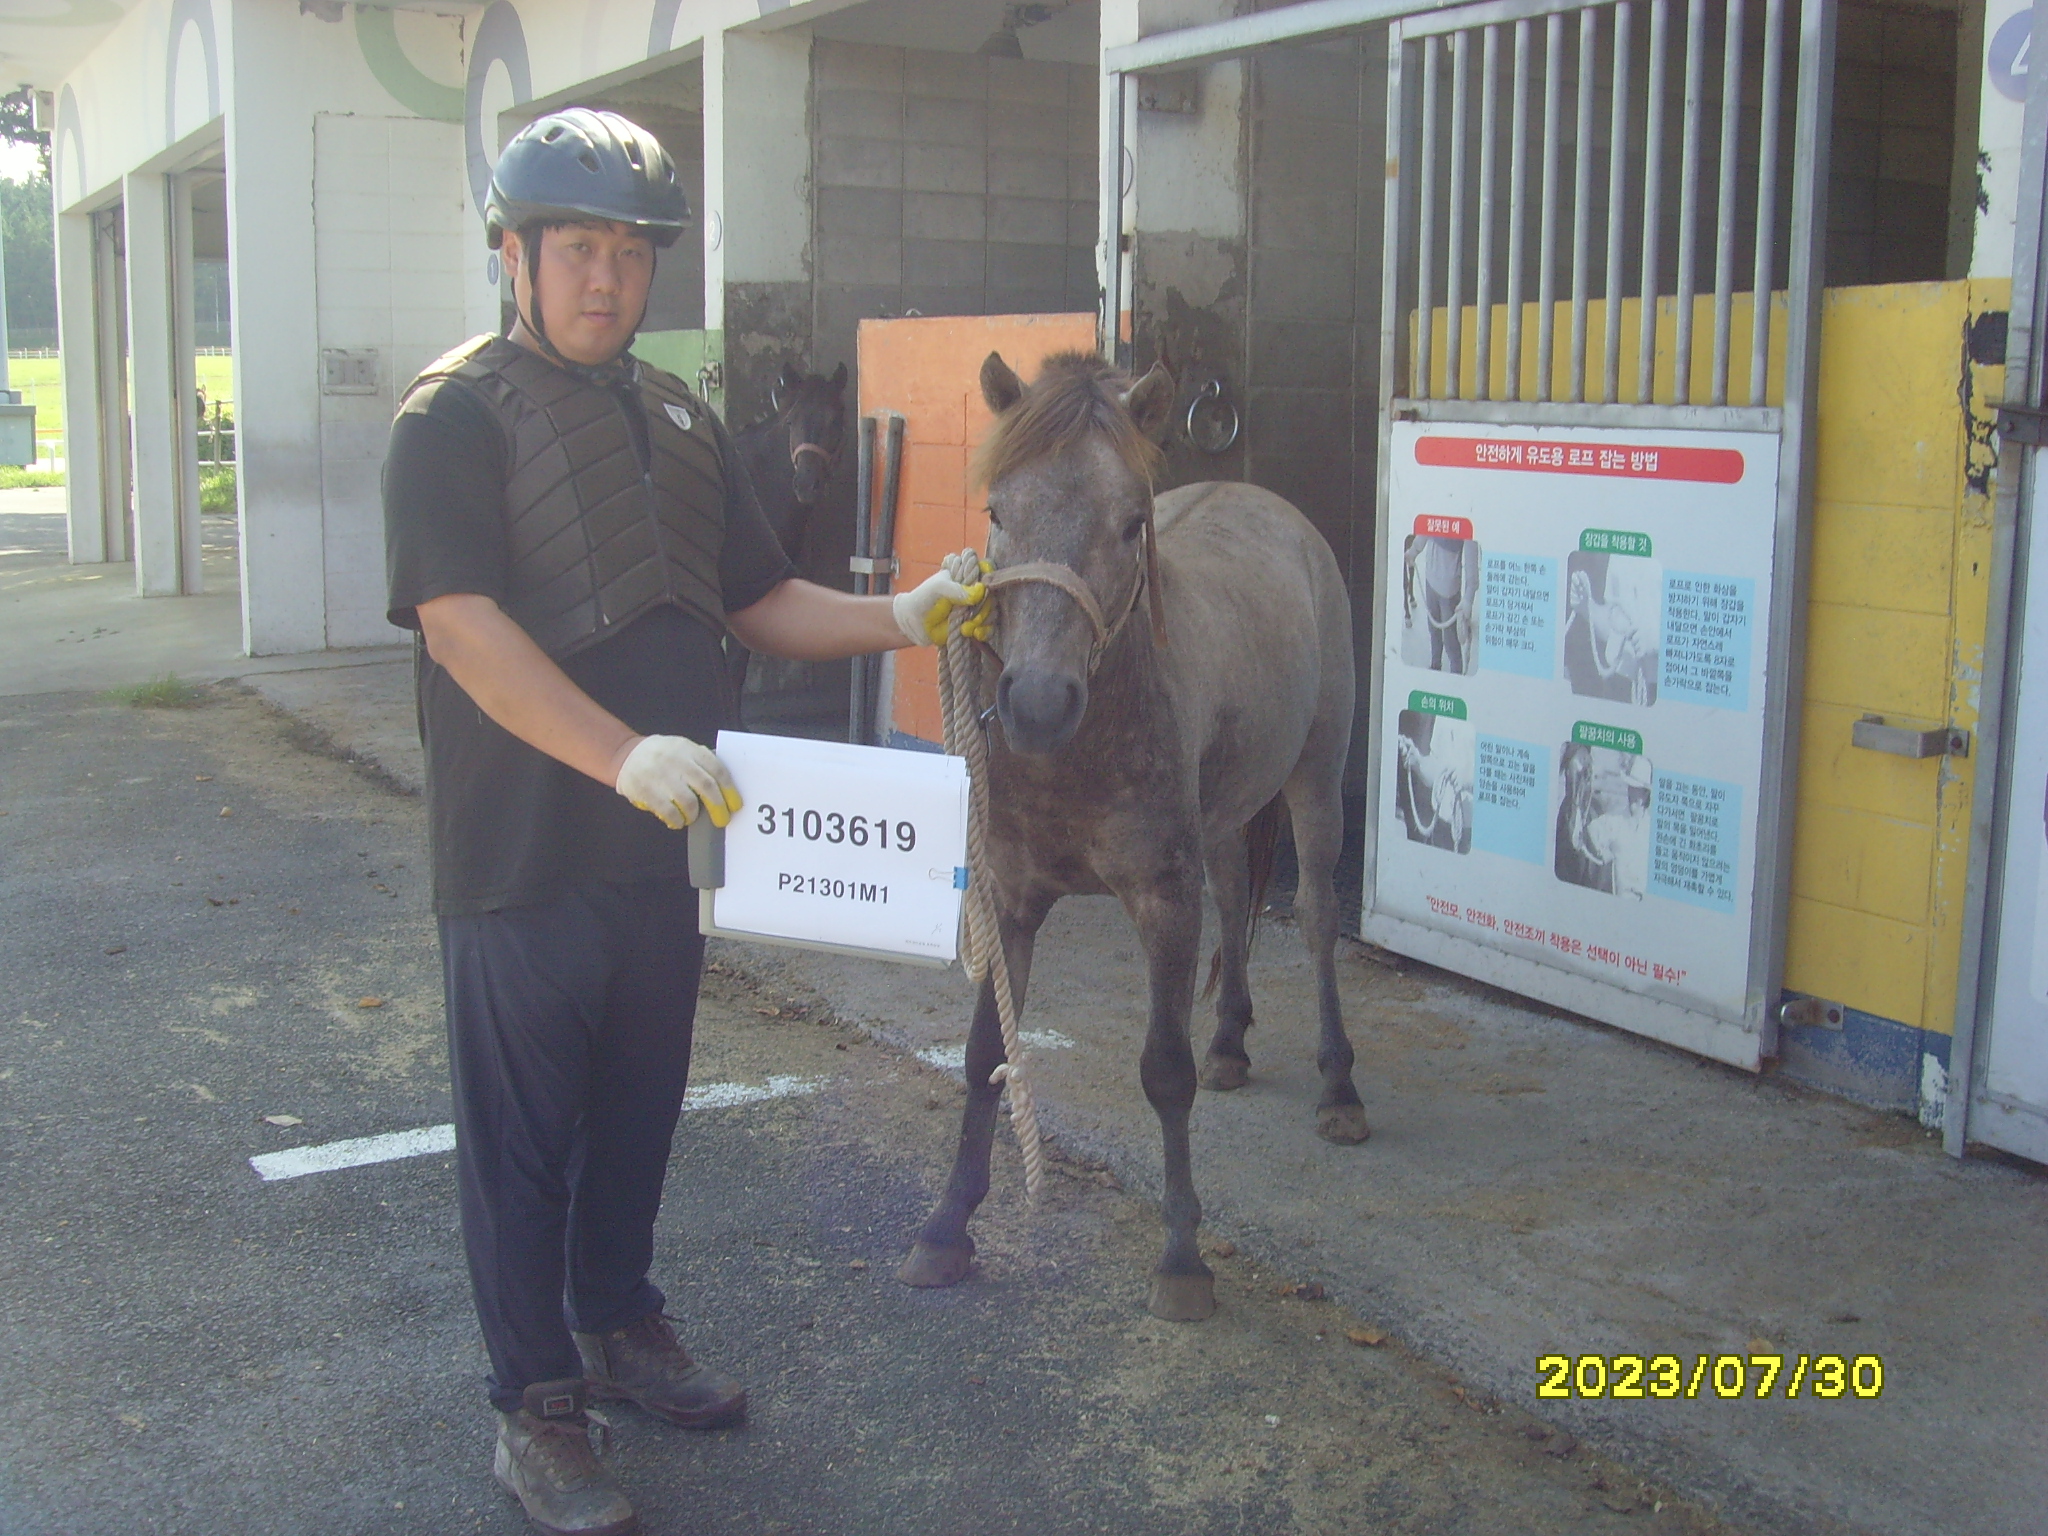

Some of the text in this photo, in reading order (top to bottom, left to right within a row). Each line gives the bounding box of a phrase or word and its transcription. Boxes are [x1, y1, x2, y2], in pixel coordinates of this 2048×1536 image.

[1475, 444, 1658, 472] 안전하게 유도용 로프 잡는 방법
[1427, 519, 1460, 534] 잘못된 예
[1584, 533, 1647, 552] 장갑을 착용할 것
[1421, 696, 1454, 712] 손의 위치
[1578, 725, 1637, 748] 팔꿈치의 사용
[757, 804, 916, 852] 3103619
[778, 873, 889, 904] P21301M1
[1466, 908, 1499, 930] 안전화,
[1503, 919, 1545, 945] 안전조끼
[1549, 932, 1582, 954] 착용은
[1587, 943, 1619, 967] 선택이
[1624, 956, 1648, 975] 아닌
